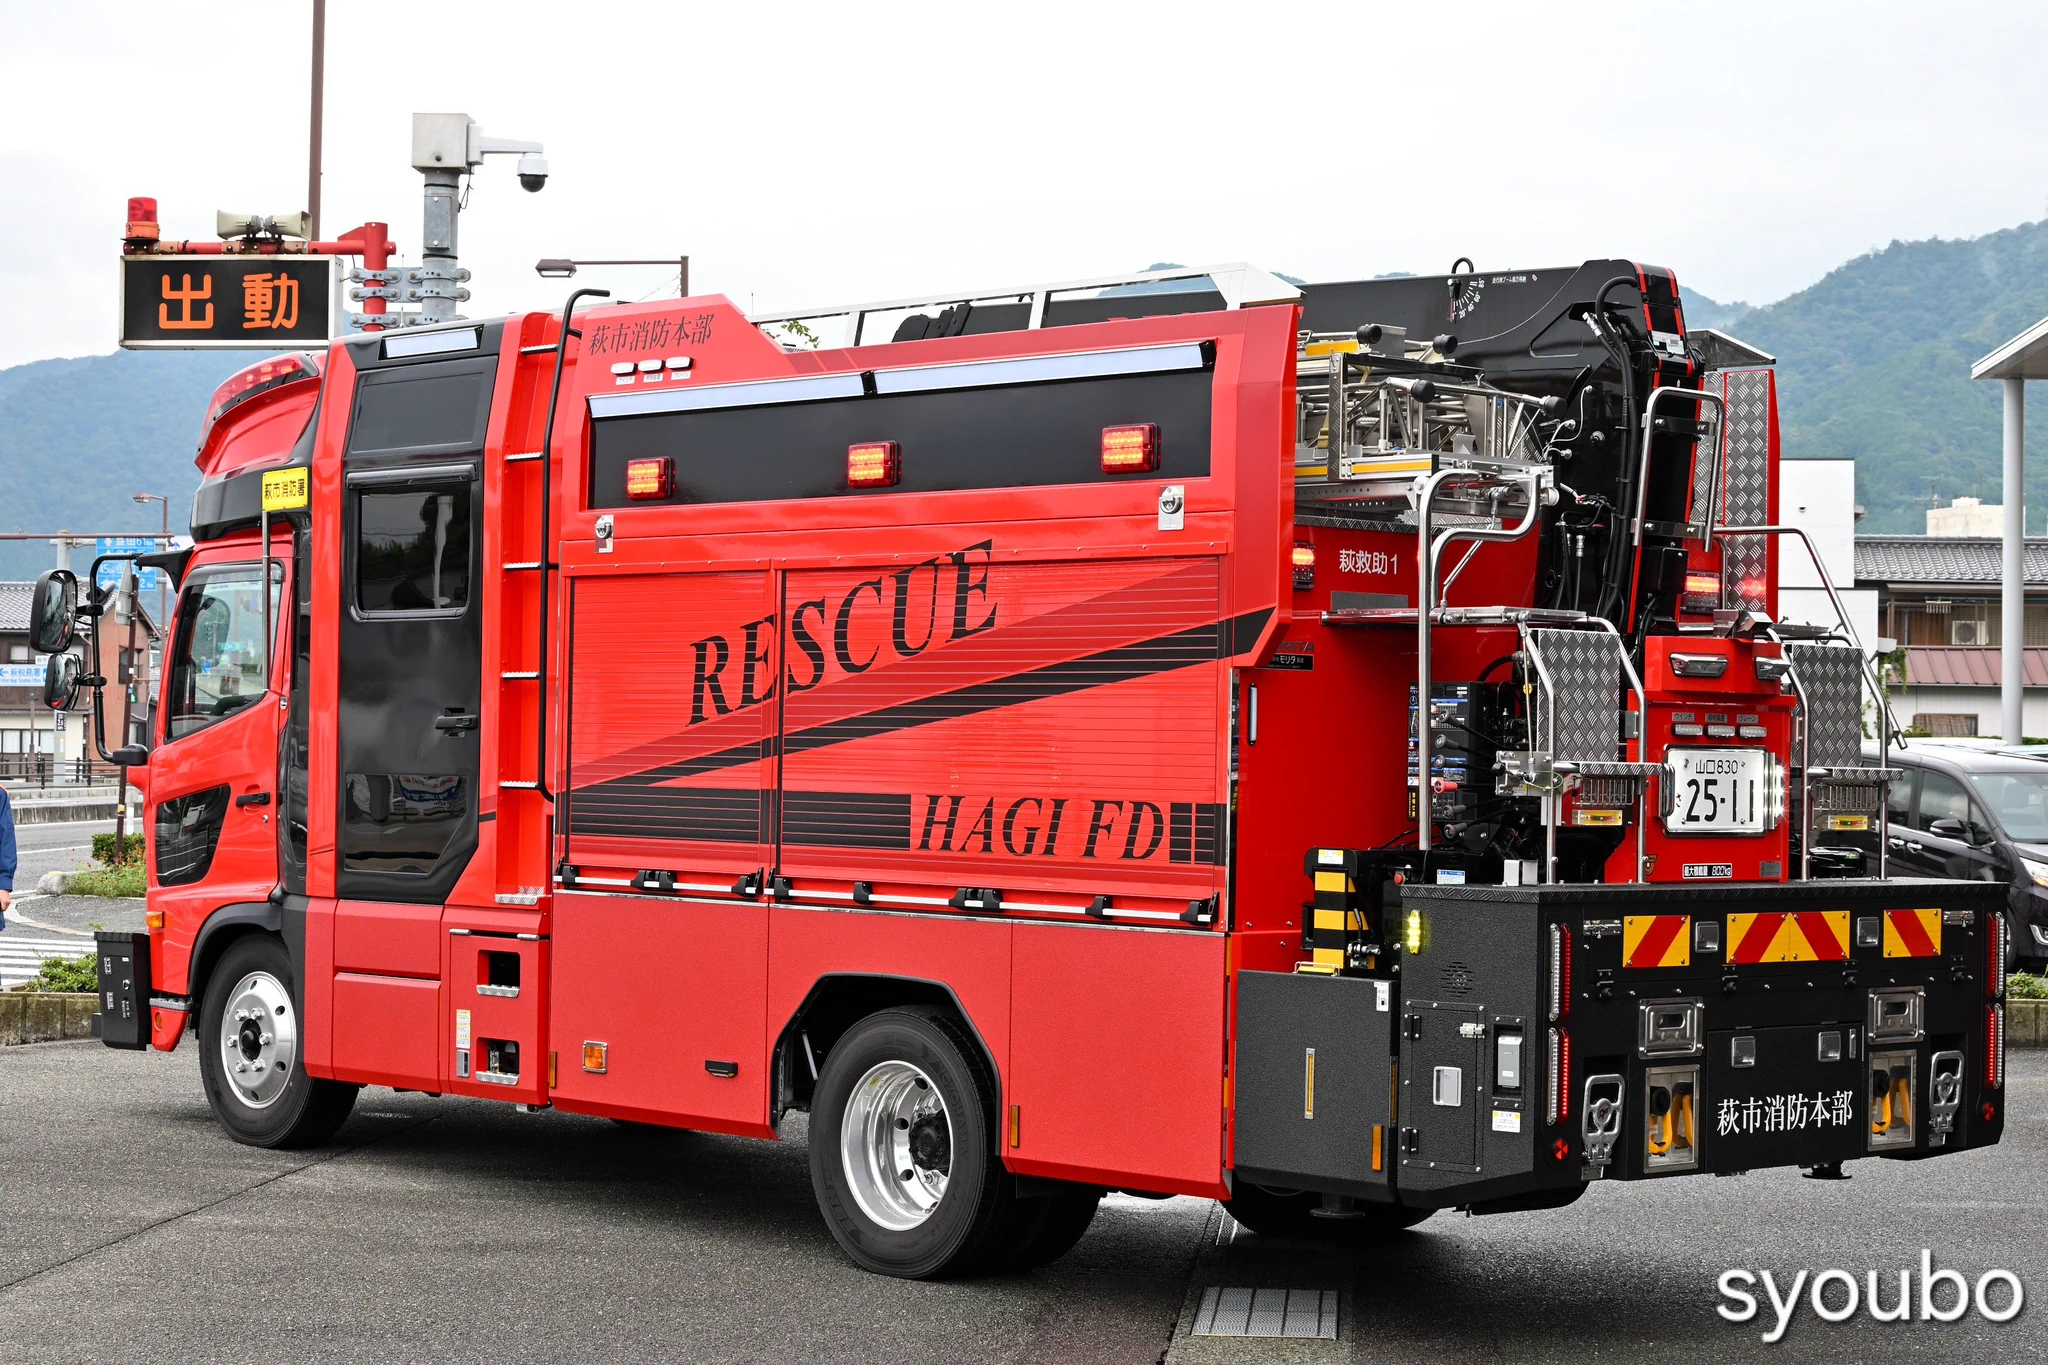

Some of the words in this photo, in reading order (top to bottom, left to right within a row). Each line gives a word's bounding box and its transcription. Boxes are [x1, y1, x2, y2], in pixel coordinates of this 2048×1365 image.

[158, 272, 309, 330] 出動
[588, 313, 715, 356] 萩市消防本部
[1339, 548, 1398, 576] 萩救助1
[685, 538, 998, 728] RESCUE
[1695, 759, 1739, 775] 山口830
[915, 794, 1070, 857] HAGI
[1080, 800, 1164, 860] FD
[1716, 1090, 1853, 1137] 萩市消防本部
